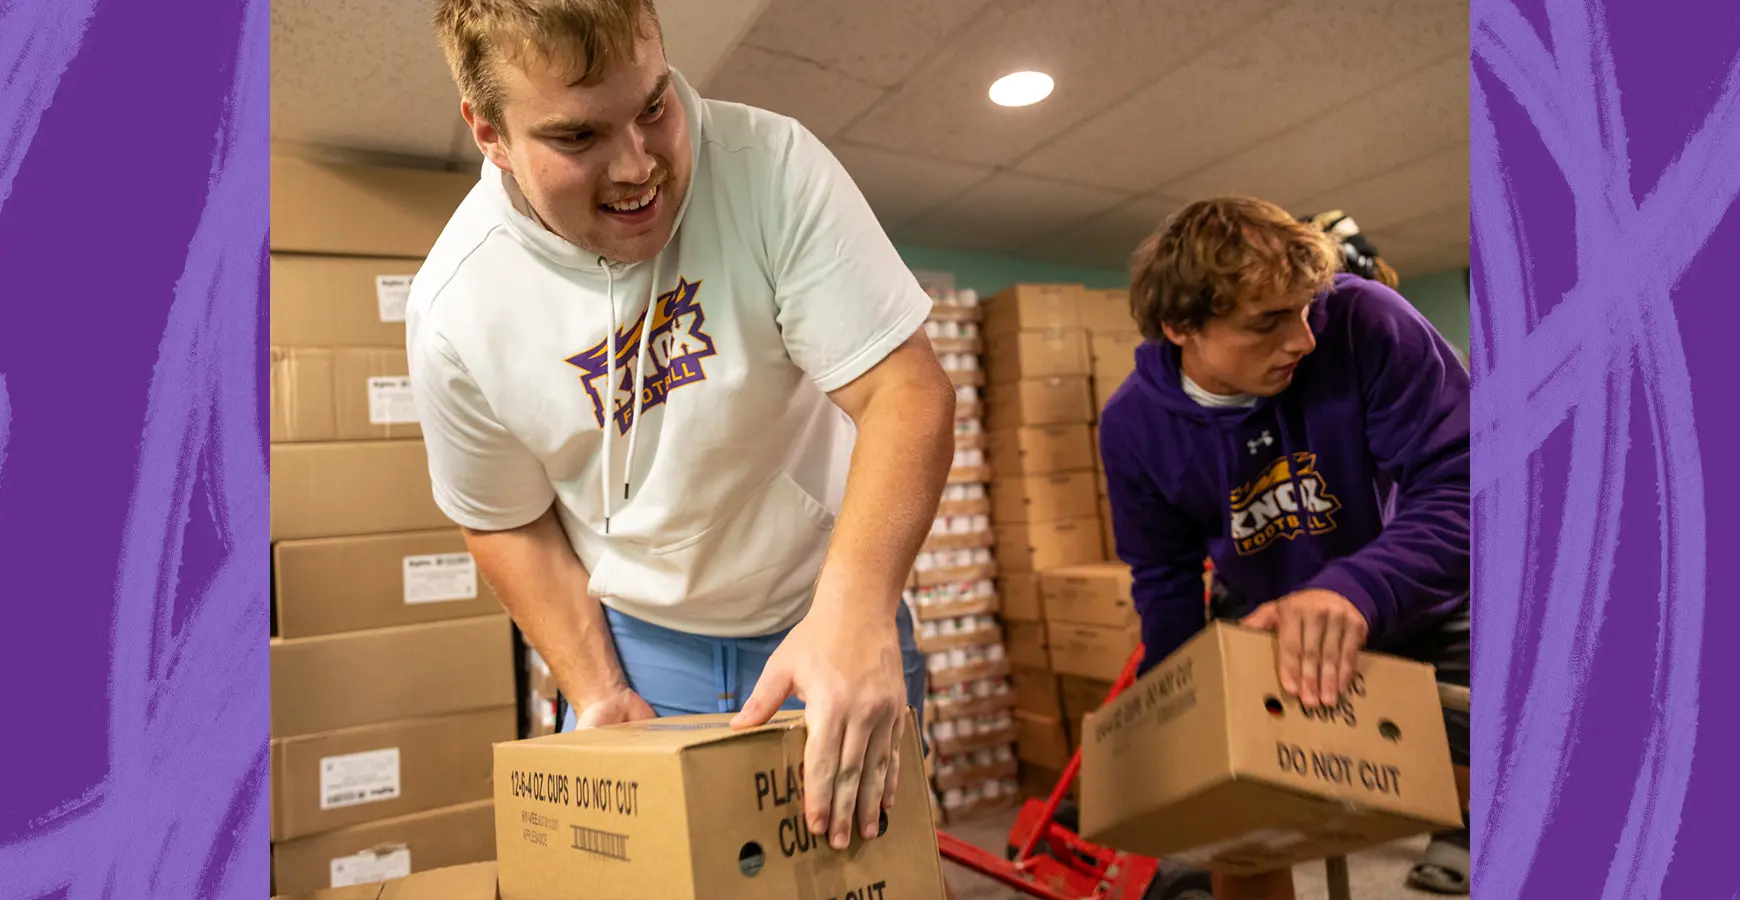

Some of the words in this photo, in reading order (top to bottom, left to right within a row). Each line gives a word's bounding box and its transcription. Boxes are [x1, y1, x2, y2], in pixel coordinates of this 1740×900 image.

[589, 310, 709, 412] KNOX
[1231, 478, 1333, 540] KNOX
[547, 773, 569, 806] CUPS
[576, 776, 590, 809] DO
[592, 778, 612, 813] NOT
[615, 779, 638, 817] CUT
[754, 761, 805, 812] PLA
[1276, 741, 1308, 777] DO
[1311, 750, 1353, 787] NOT
[1358, 759, 1401, 798] CUT
